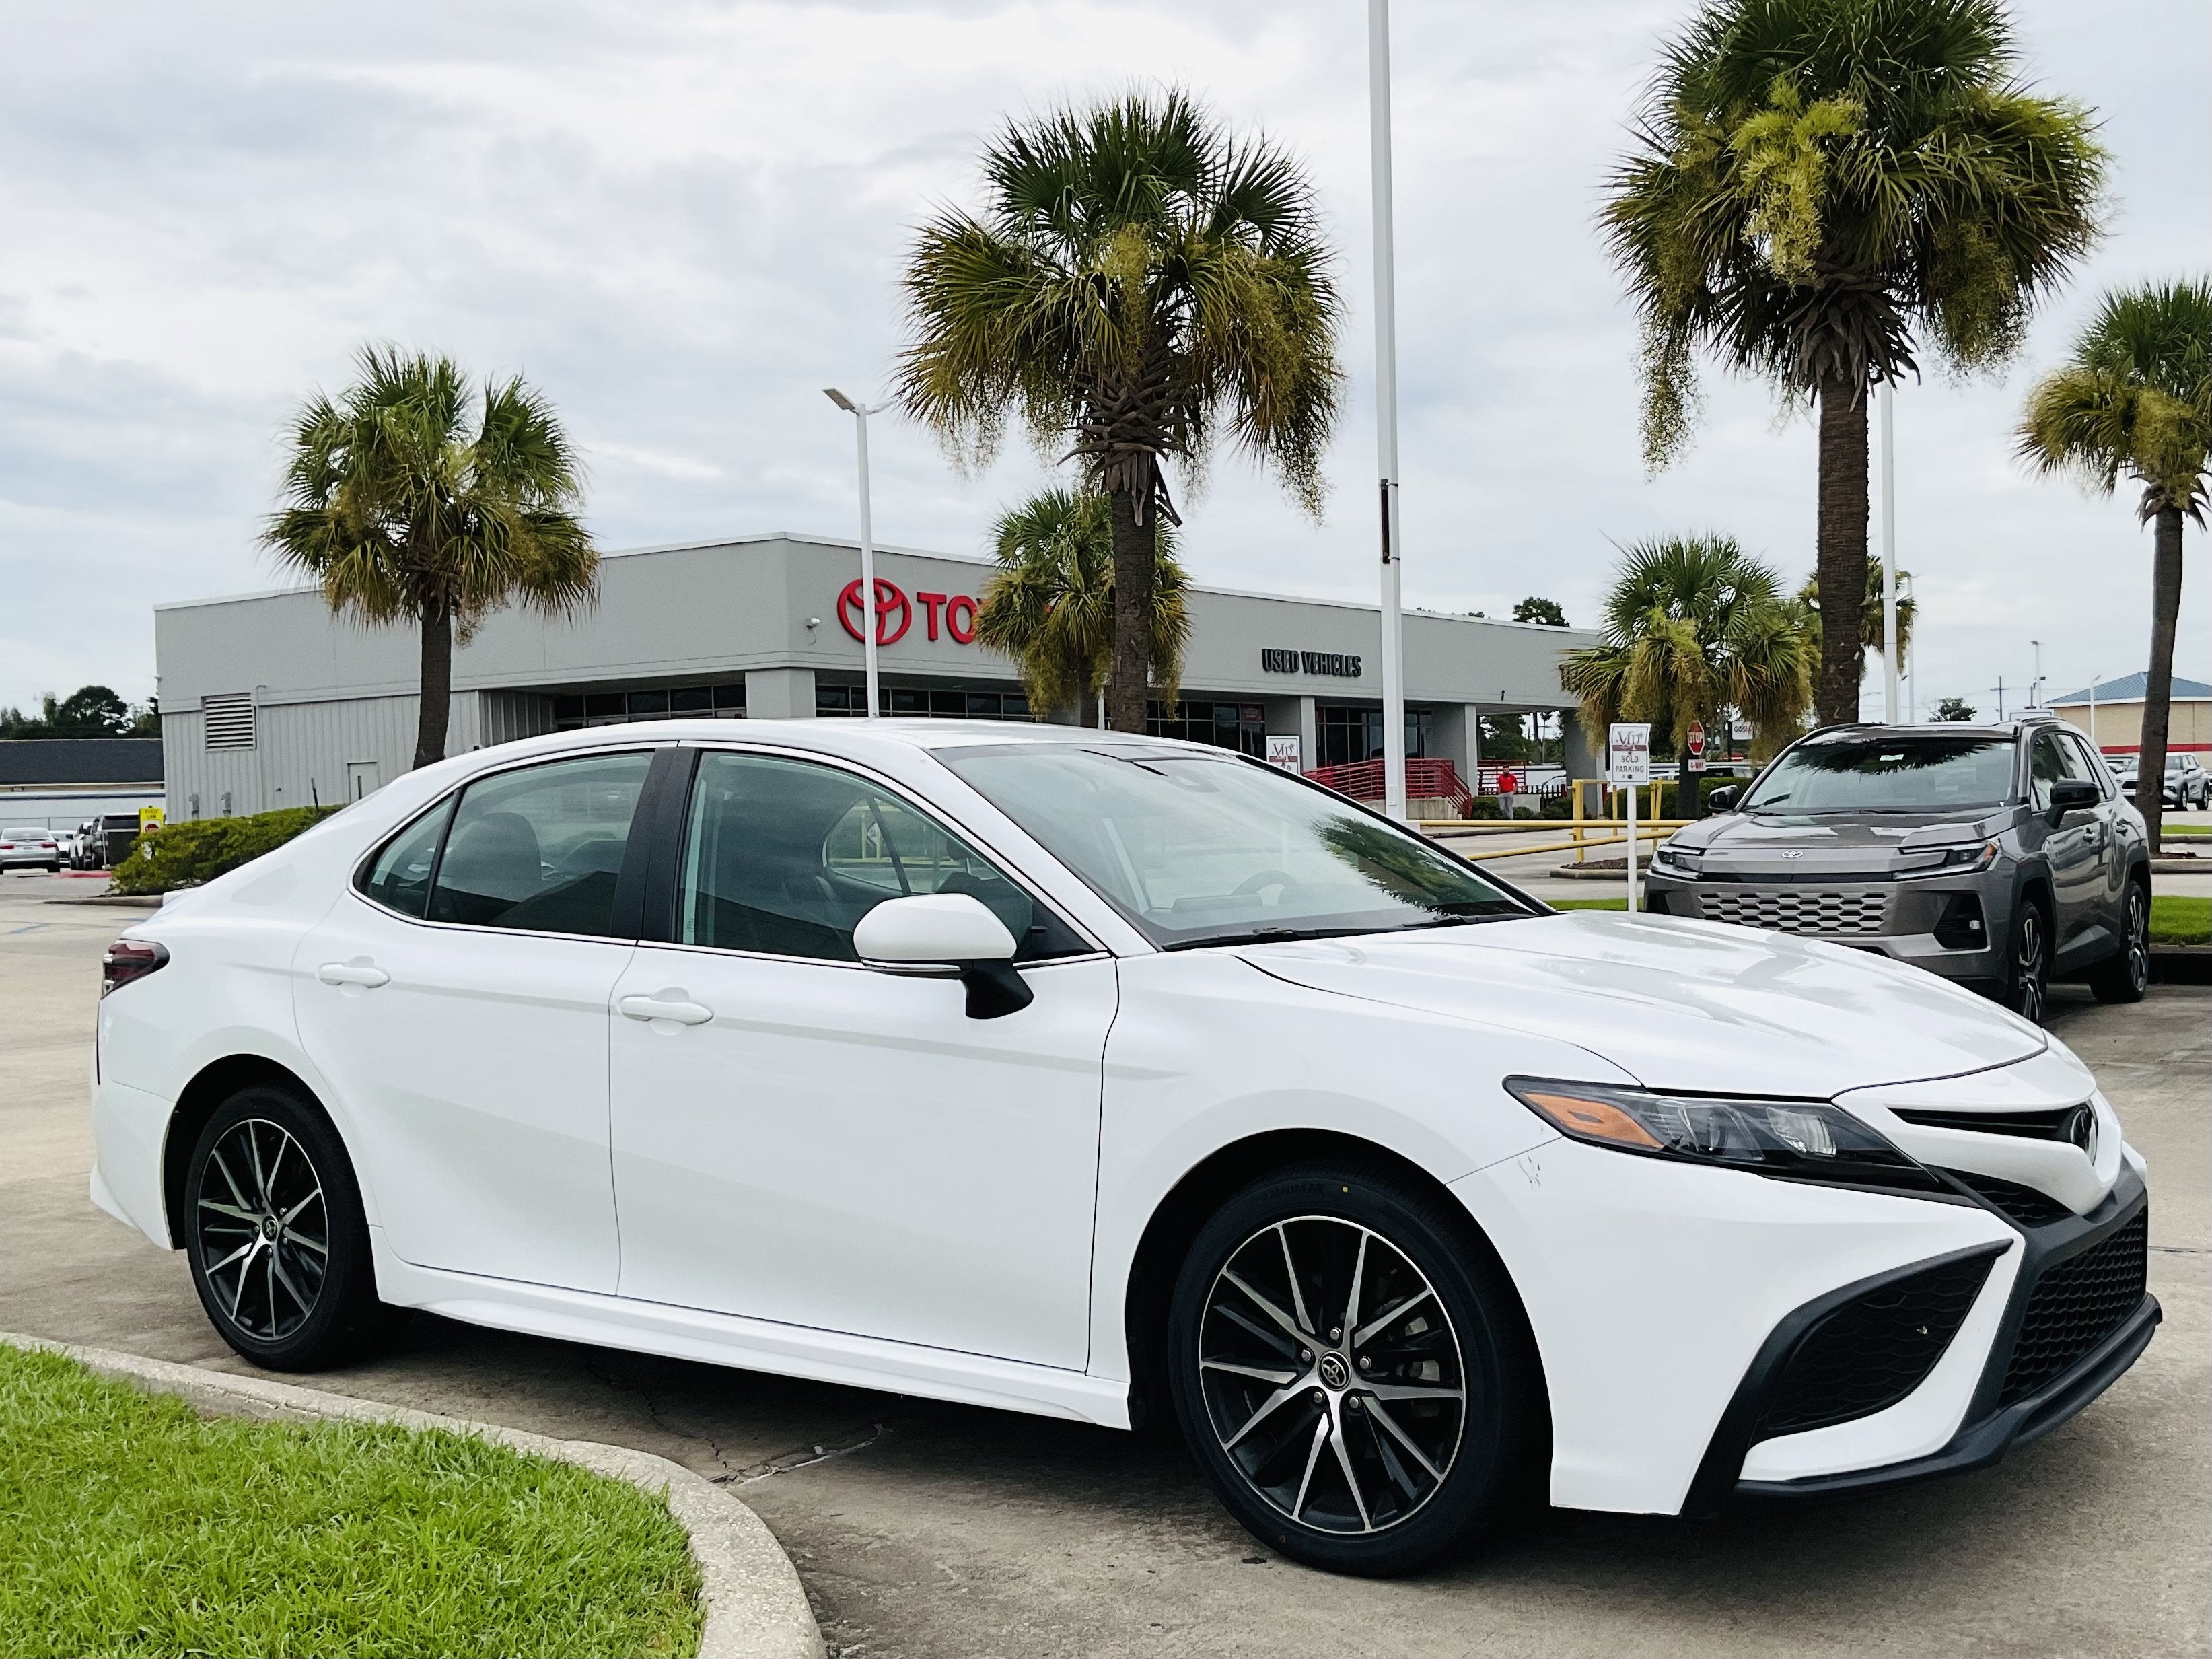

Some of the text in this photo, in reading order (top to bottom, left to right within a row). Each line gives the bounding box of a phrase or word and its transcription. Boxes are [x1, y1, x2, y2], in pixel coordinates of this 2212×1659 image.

[1262, 648, 1361, 677] USED VEHICLES
[1688, 732, 1703, 744] STOP
[1690, 761, 1704, 769] 4-WAY
